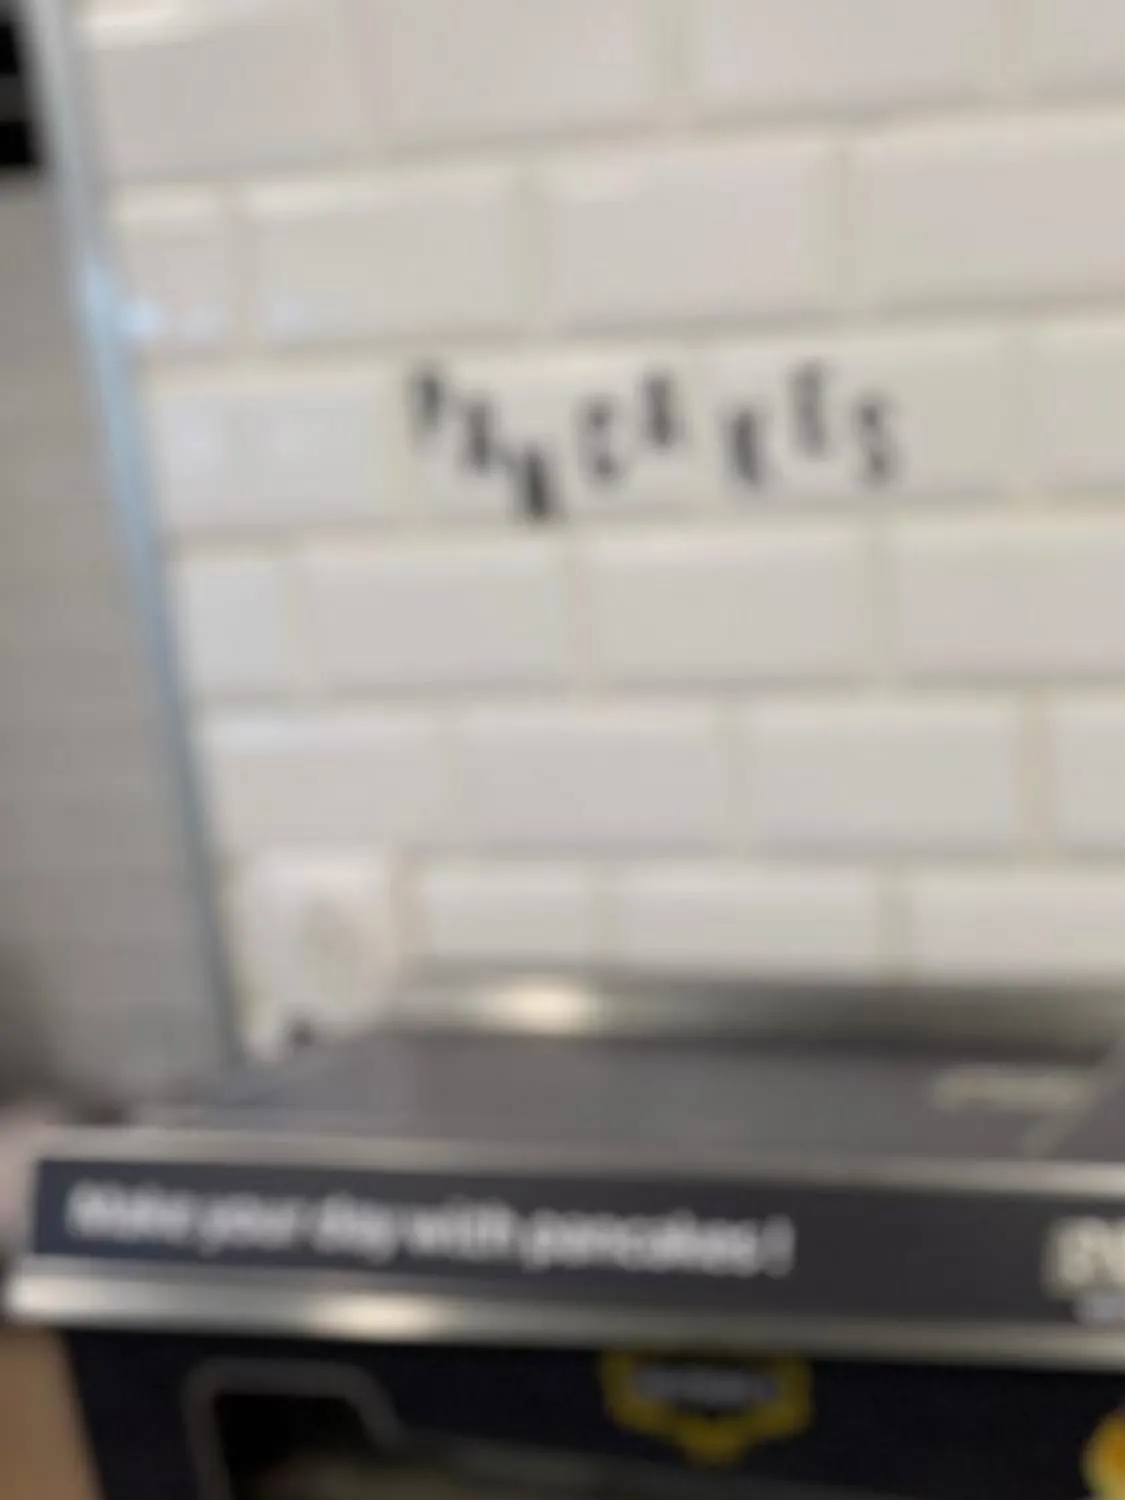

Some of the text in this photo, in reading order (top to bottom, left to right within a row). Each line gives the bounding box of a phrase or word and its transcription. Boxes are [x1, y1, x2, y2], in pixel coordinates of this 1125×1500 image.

[67, 1183, 191, 1243] Make
[199, 1196, 297, 1254] your
[310, 1193, 397, 1262] day
[407, 1197, 513, 1260] with
